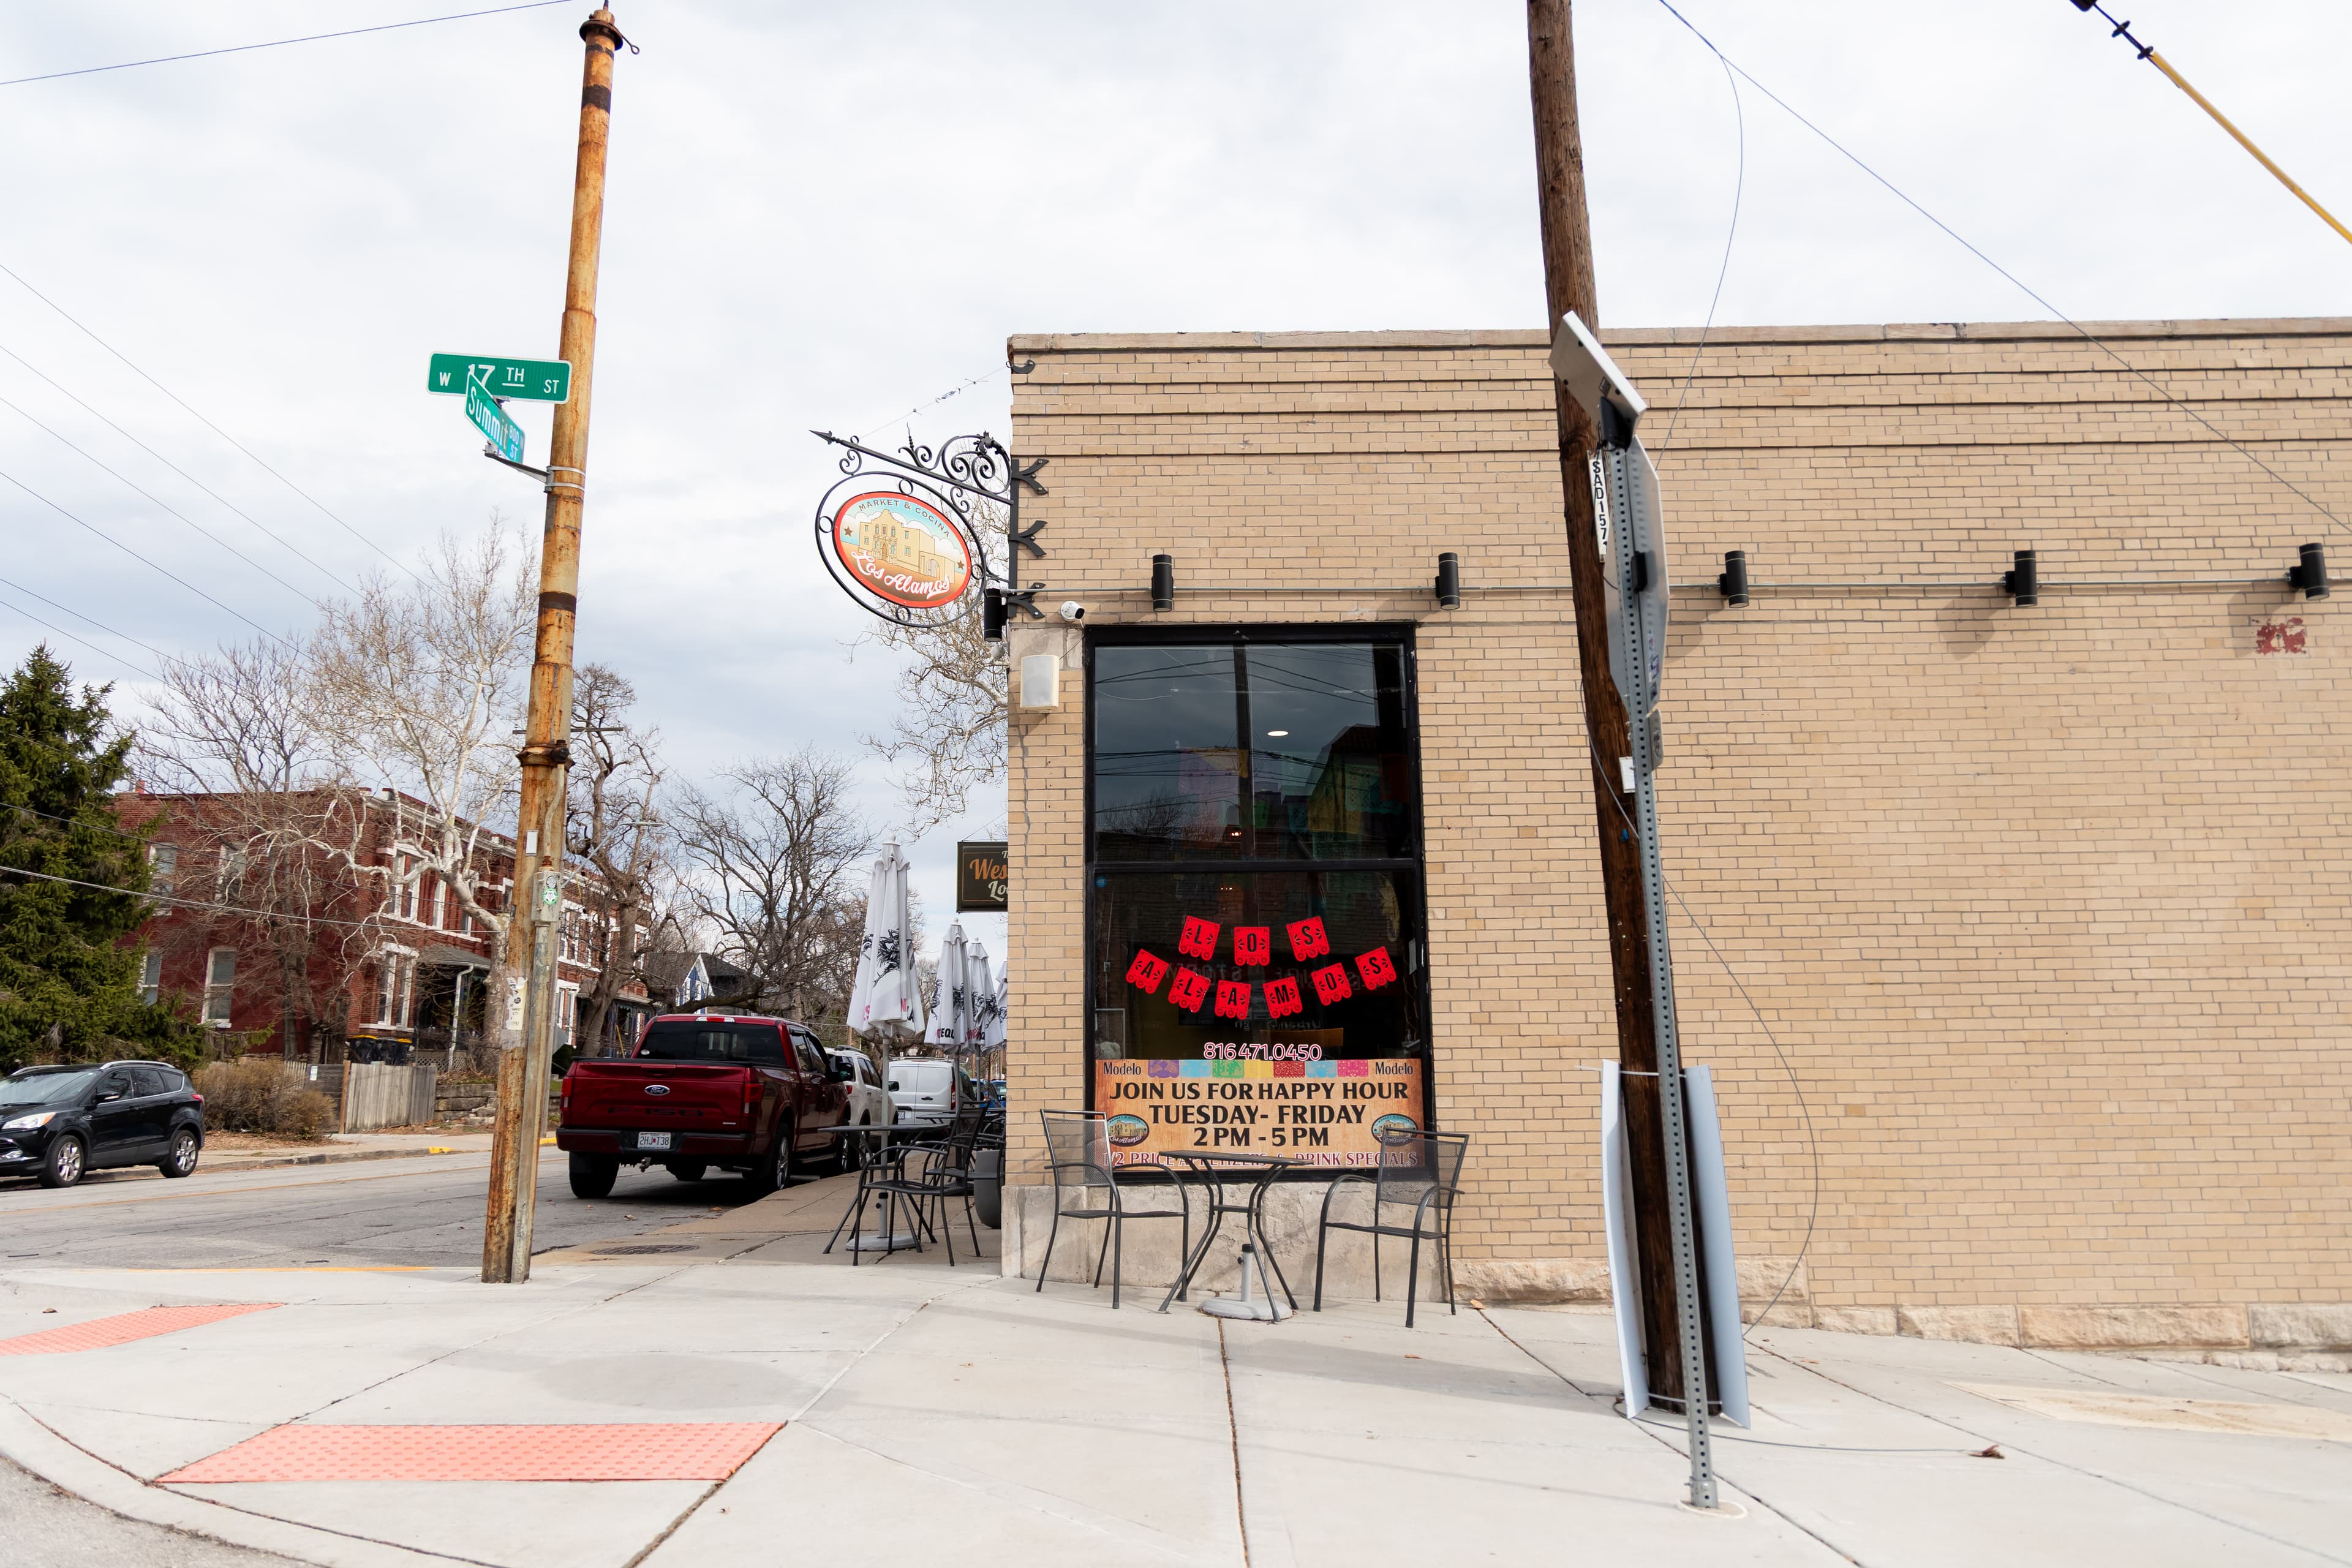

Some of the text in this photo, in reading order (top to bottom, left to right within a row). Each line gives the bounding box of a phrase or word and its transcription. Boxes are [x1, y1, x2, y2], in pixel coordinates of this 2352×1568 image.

[439, 372, 451, 386] W
[507, 368, 525, 382] TH
[543, 379, 559, 394] ST
[469, 386, 508, 450] Summit
[510, 444, 518, 461] ST
[859, 499, 899, 511] MARKET
[915, 507, 949, 538] COCINA
[851, 550, 951, 600] Los Alamos
[1194, 924, 1314, 953] LOS
[1140, 956, 1382, 1006] ALAMOS
[1204, 1042, 1322, 1060] 816 471.0450
[1103, 1061, 1142, 1076] Modelo
[1375, 1061, 1414, 1075] Modelo
[1109, 1082, 1409, 1099] JOIN US FOR HAPPY HOUR
[1278, 1105, 1366, 1124] FRIDAY
[1129, 1152, 1174, 1166] PRICE
[1345, 1152, 1417, 1167] SPECIALS
